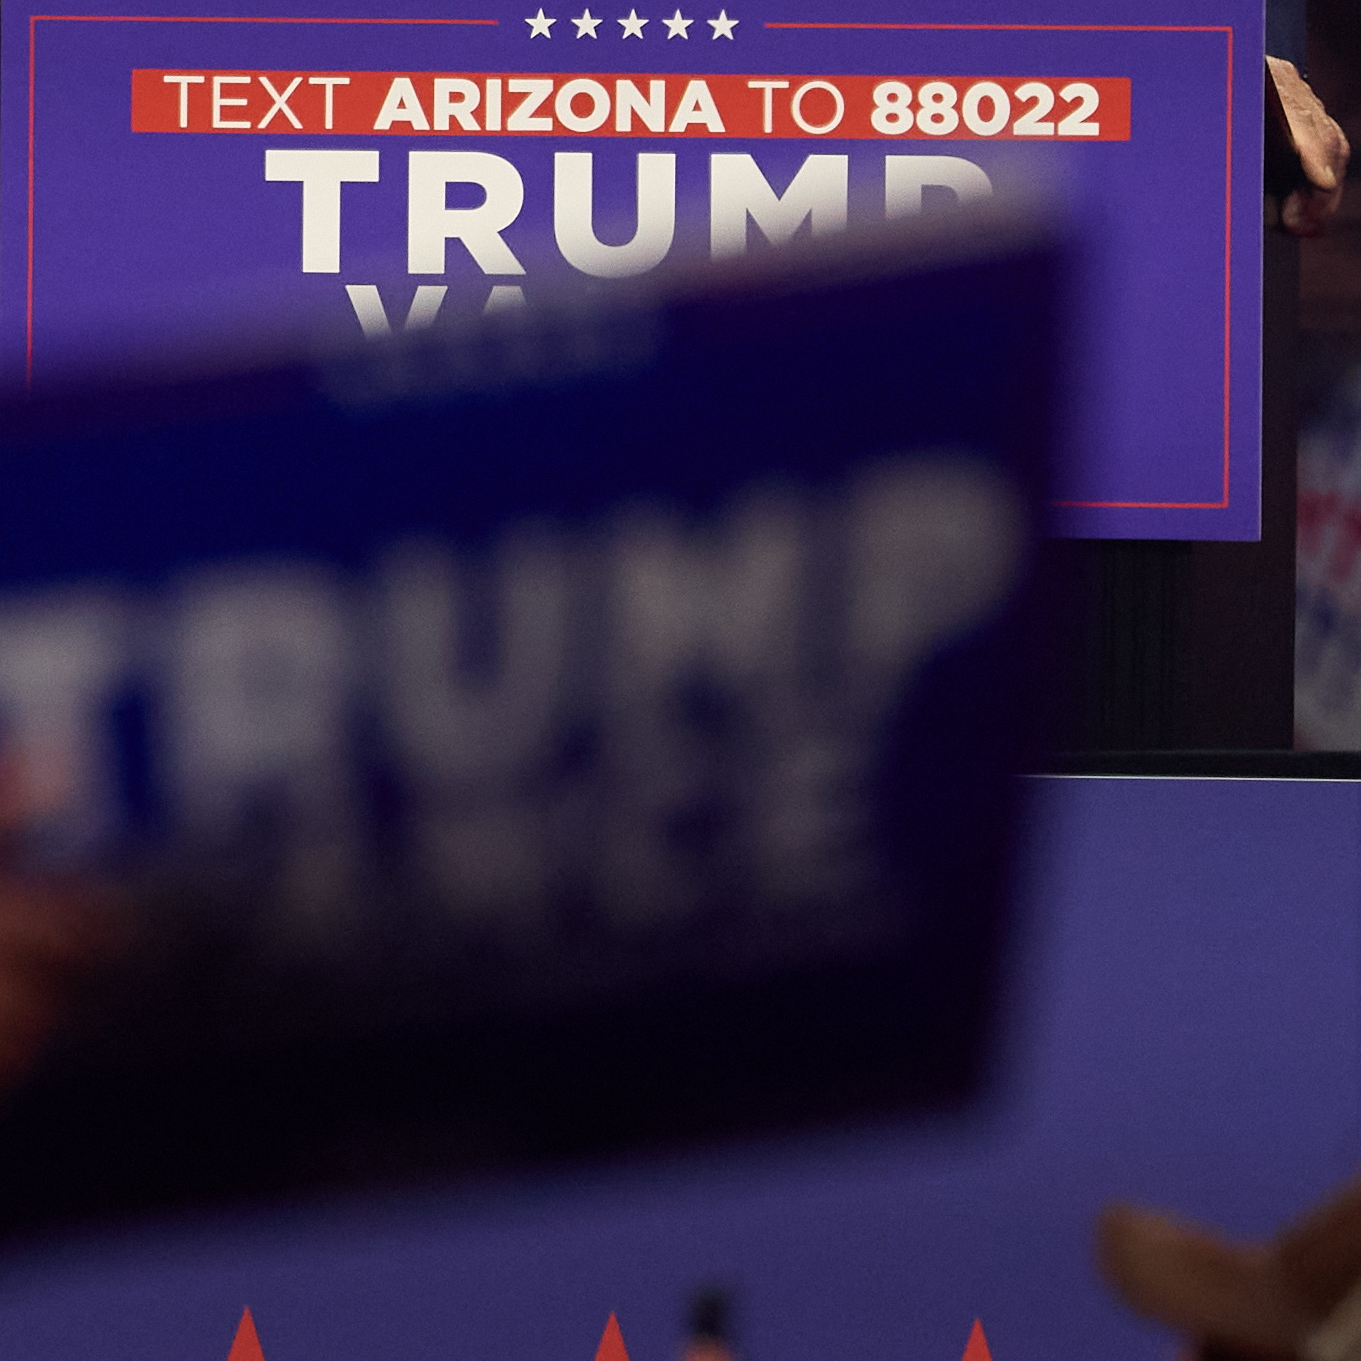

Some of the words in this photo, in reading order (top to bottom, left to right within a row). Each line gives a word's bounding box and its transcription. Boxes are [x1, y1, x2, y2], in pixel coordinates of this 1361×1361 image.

[163, 75, 350, 130] TEXT
[373, 78, 726, 135] ARIZONA
[746, 80, 845, 134] TO
[870, 81, 1101, 138] 88022
